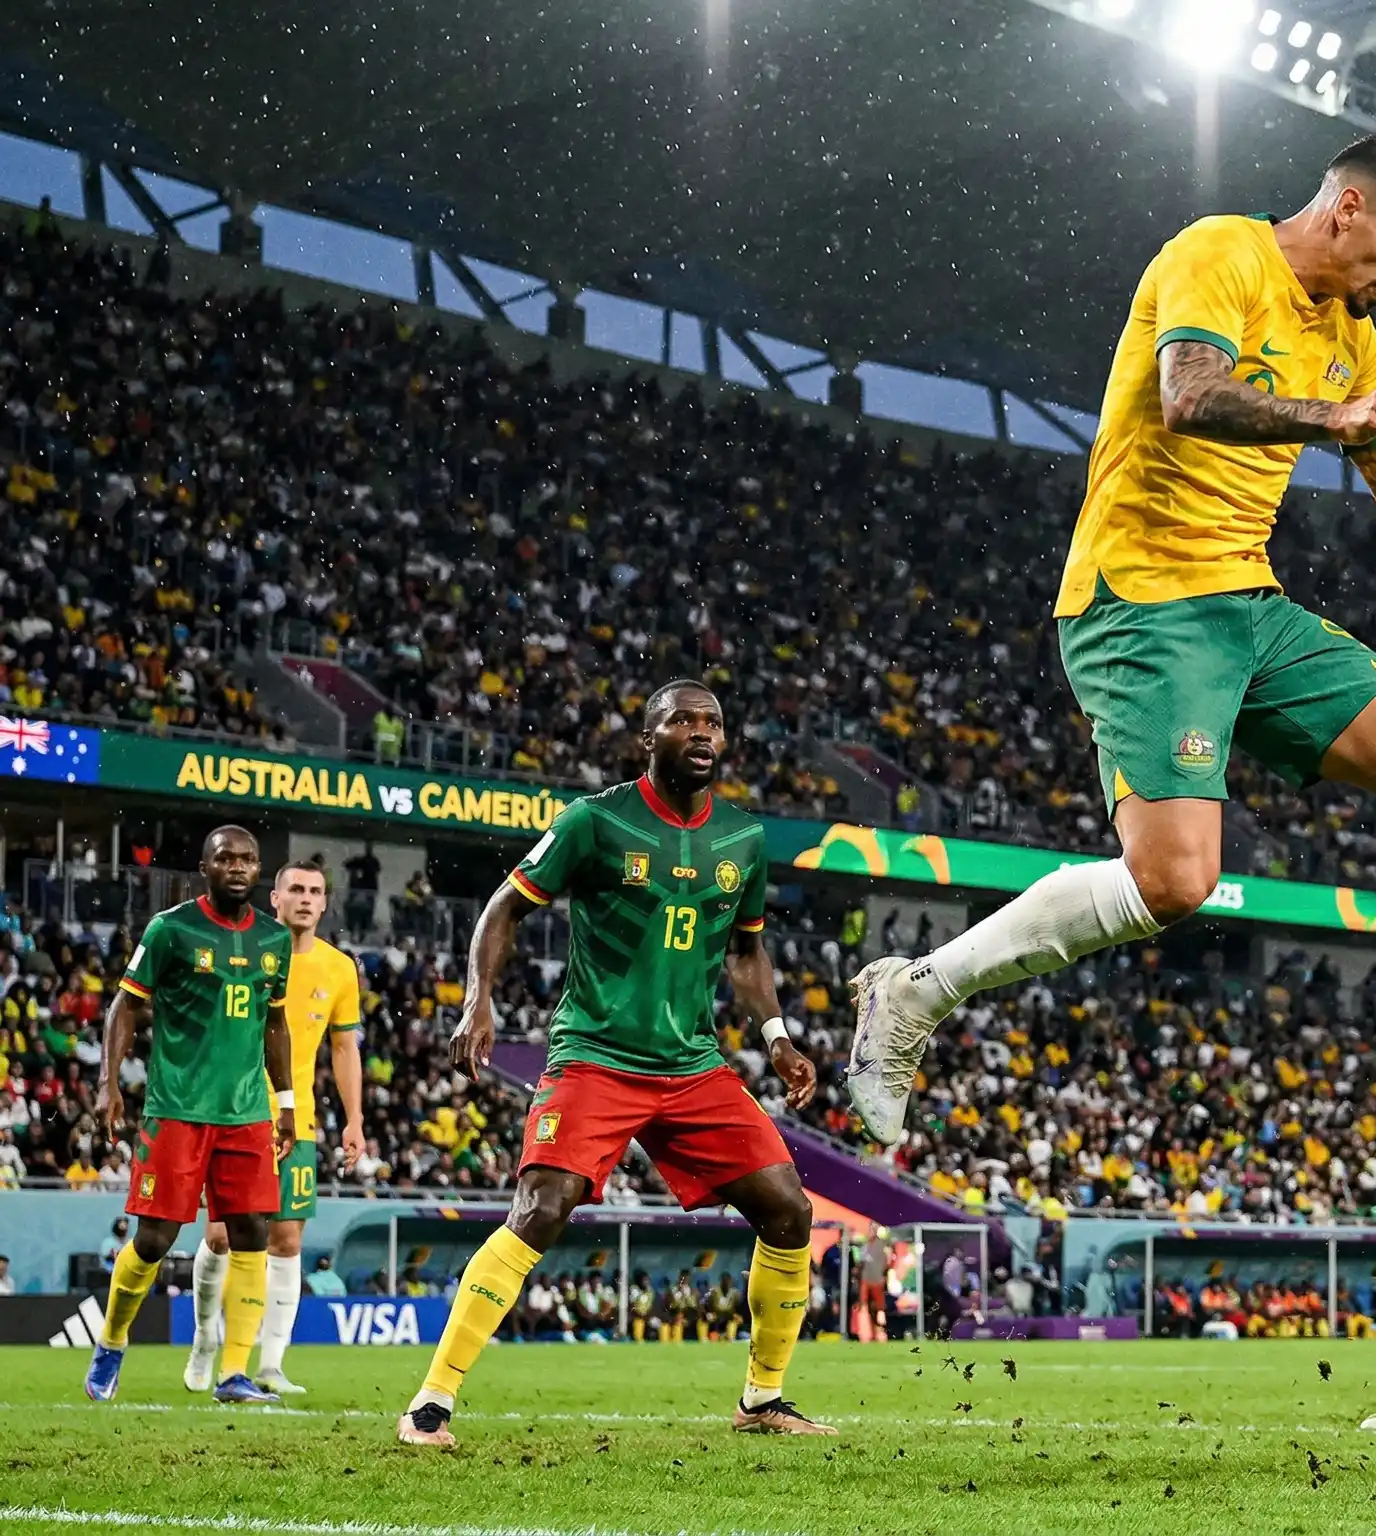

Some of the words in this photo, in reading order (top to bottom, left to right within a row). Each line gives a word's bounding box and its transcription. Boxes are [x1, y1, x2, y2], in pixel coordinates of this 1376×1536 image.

[176, 752, 373, 811] AUSTRALIA
[663, 905, 697, 950] 13
[226, 984, 250, 1018] 12
[290, 1166, 314, 1197] 10
[327, 1302, 420, 1346] VISA
